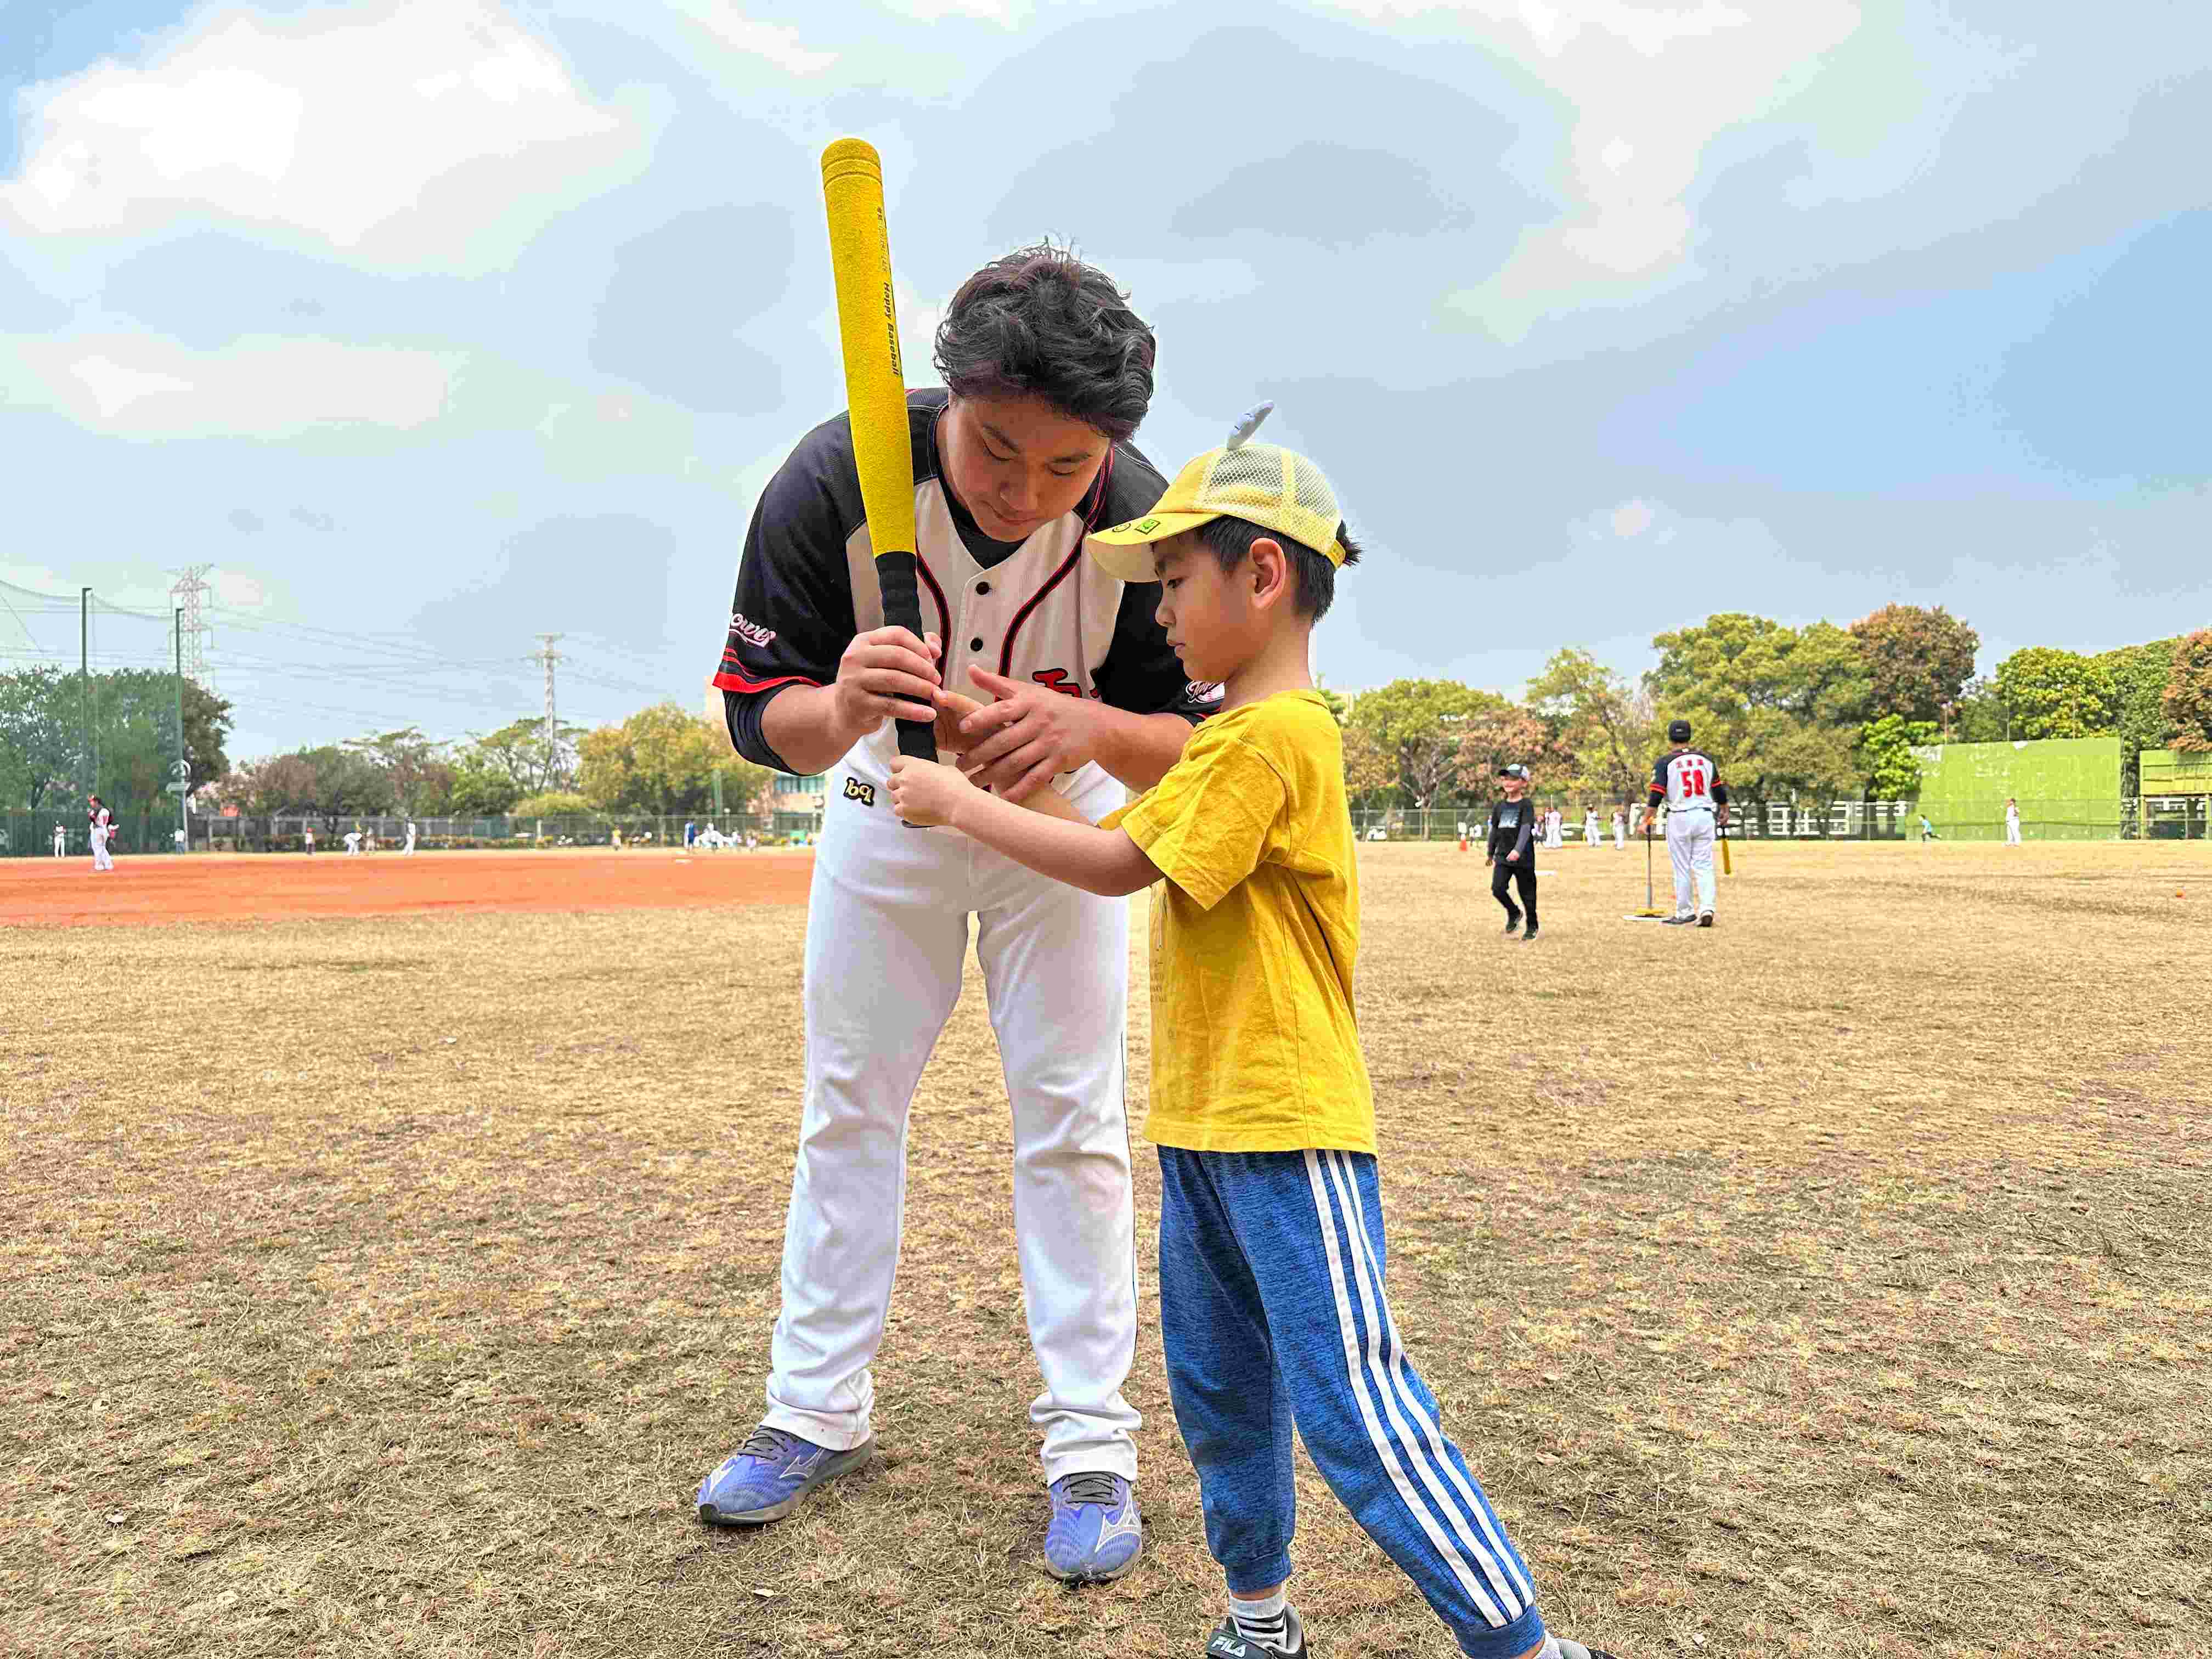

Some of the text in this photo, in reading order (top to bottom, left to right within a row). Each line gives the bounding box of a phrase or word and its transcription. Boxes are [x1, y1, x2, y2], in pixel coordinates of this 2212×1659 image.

[883, 281, 900, 376] Happy Baseball
[1211, 1635, 1246, 1657] FILA
